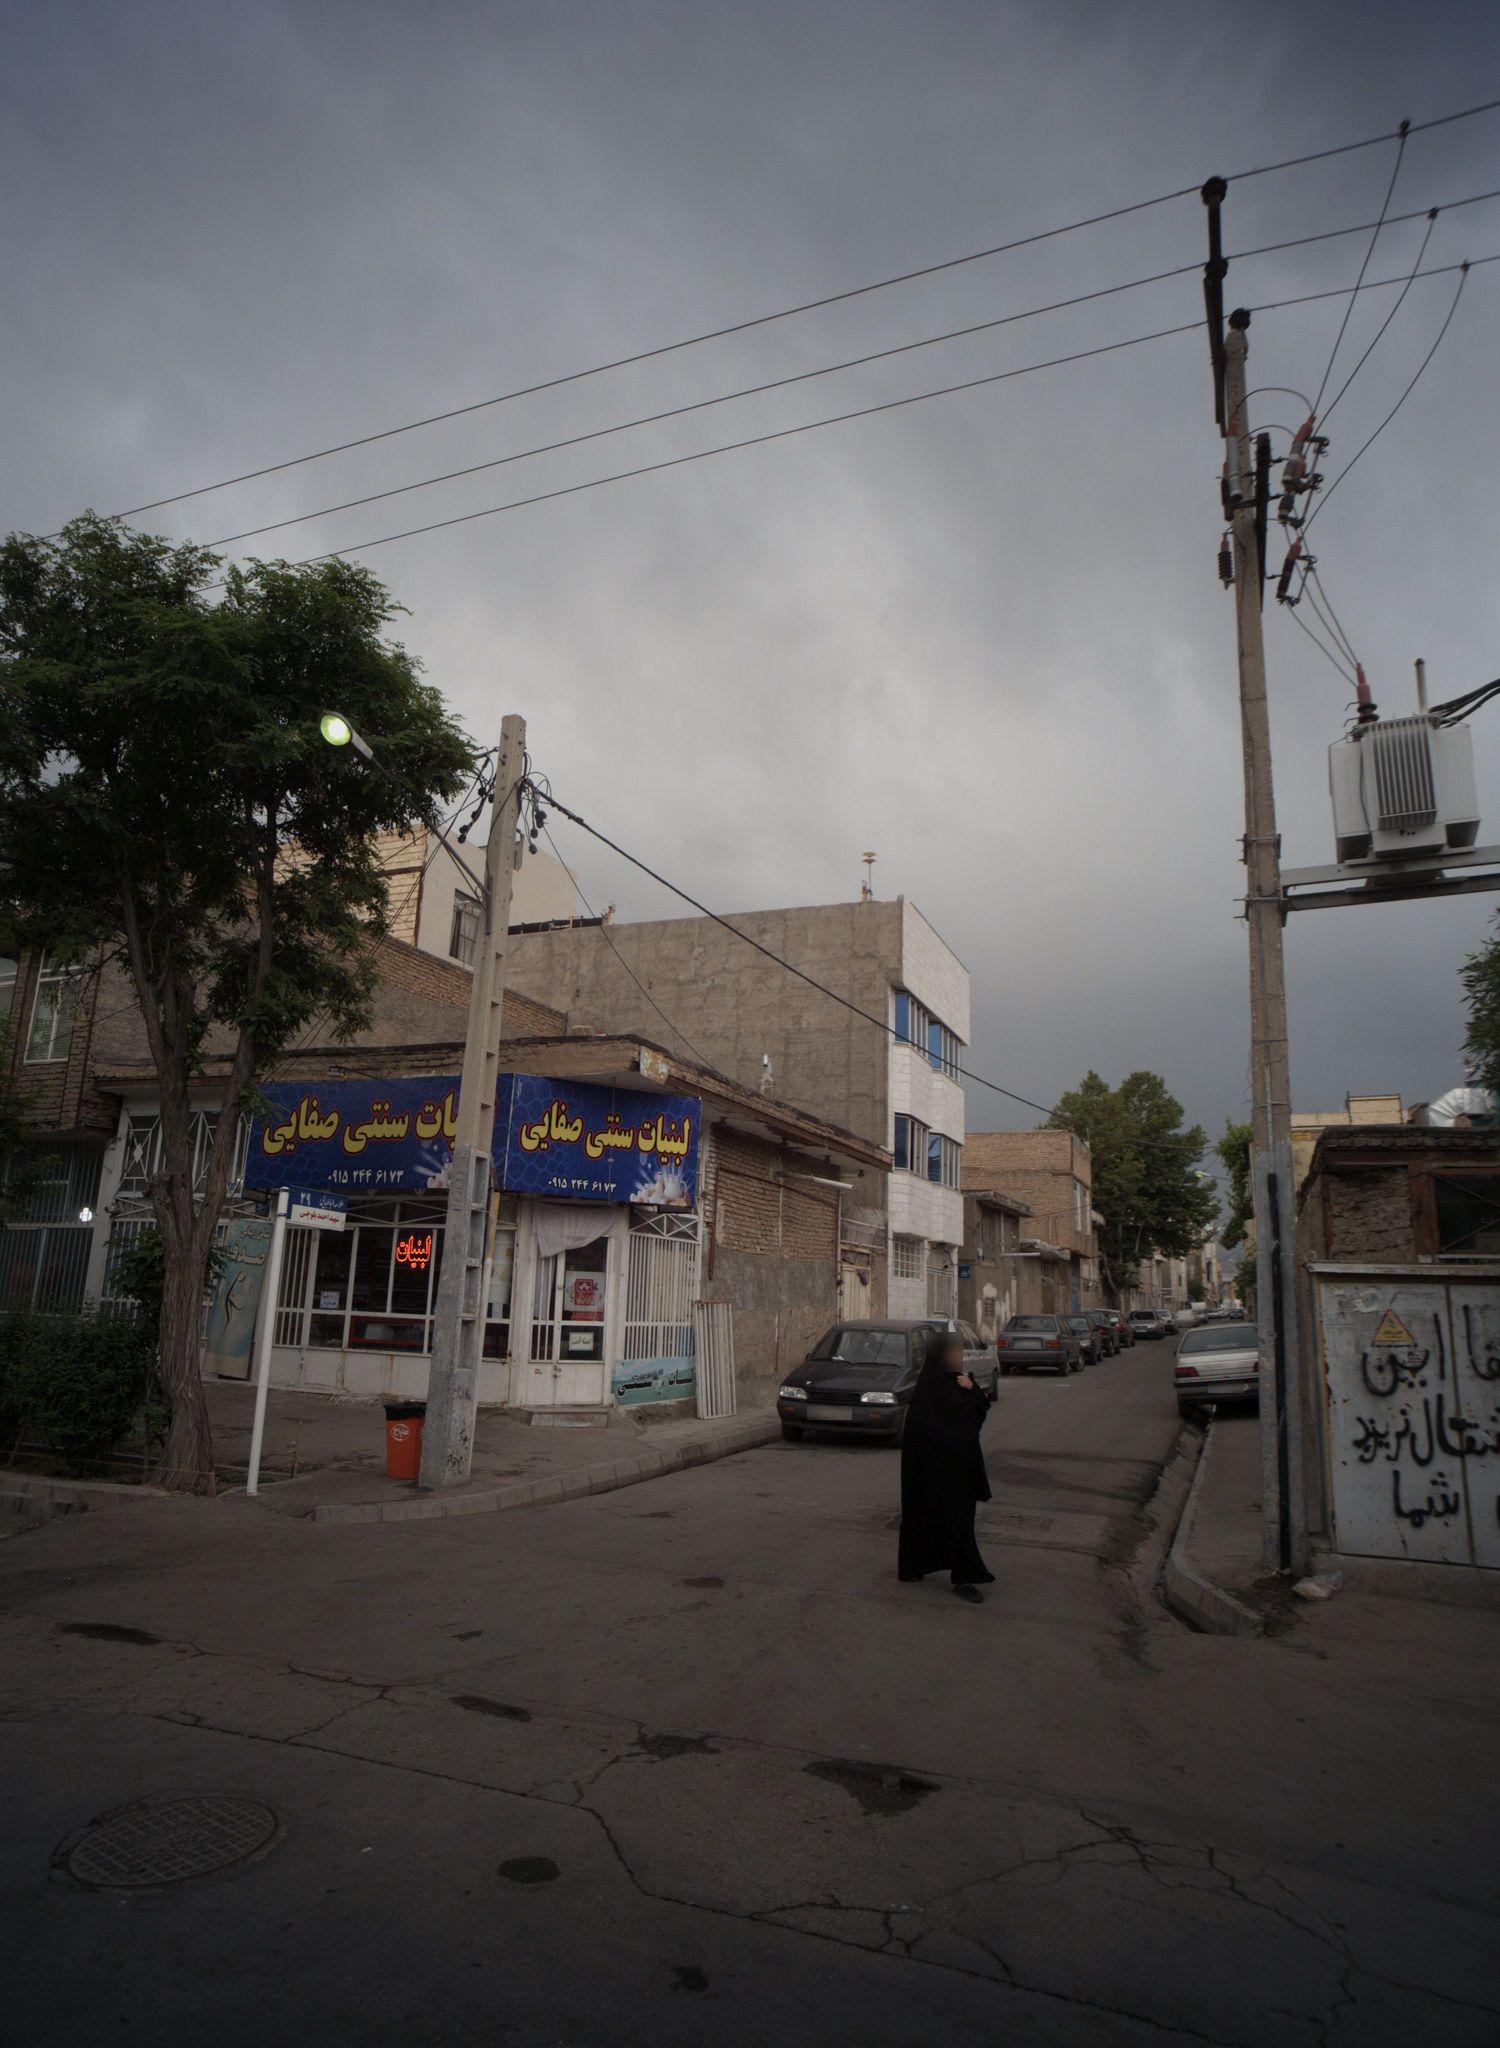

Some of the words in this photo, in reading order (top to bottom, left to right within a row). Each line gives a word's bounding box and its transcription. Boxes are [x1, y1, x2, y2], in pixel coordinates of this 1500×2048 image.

[260, 1095, 341, 1156] صفایی
[342, 1100, 411, 1156] سنتی
[518, 1098, 585, 1152] صفایی
[584, 1112, 635, 1160] سنتی
[636, 1112, 692, 1167] لبنیات
[300, 1191, 311, 1206] ۲۹
[395, 1234, 432, 1269] لبنیات
[1393, 1469, 1459, 1528] شما
